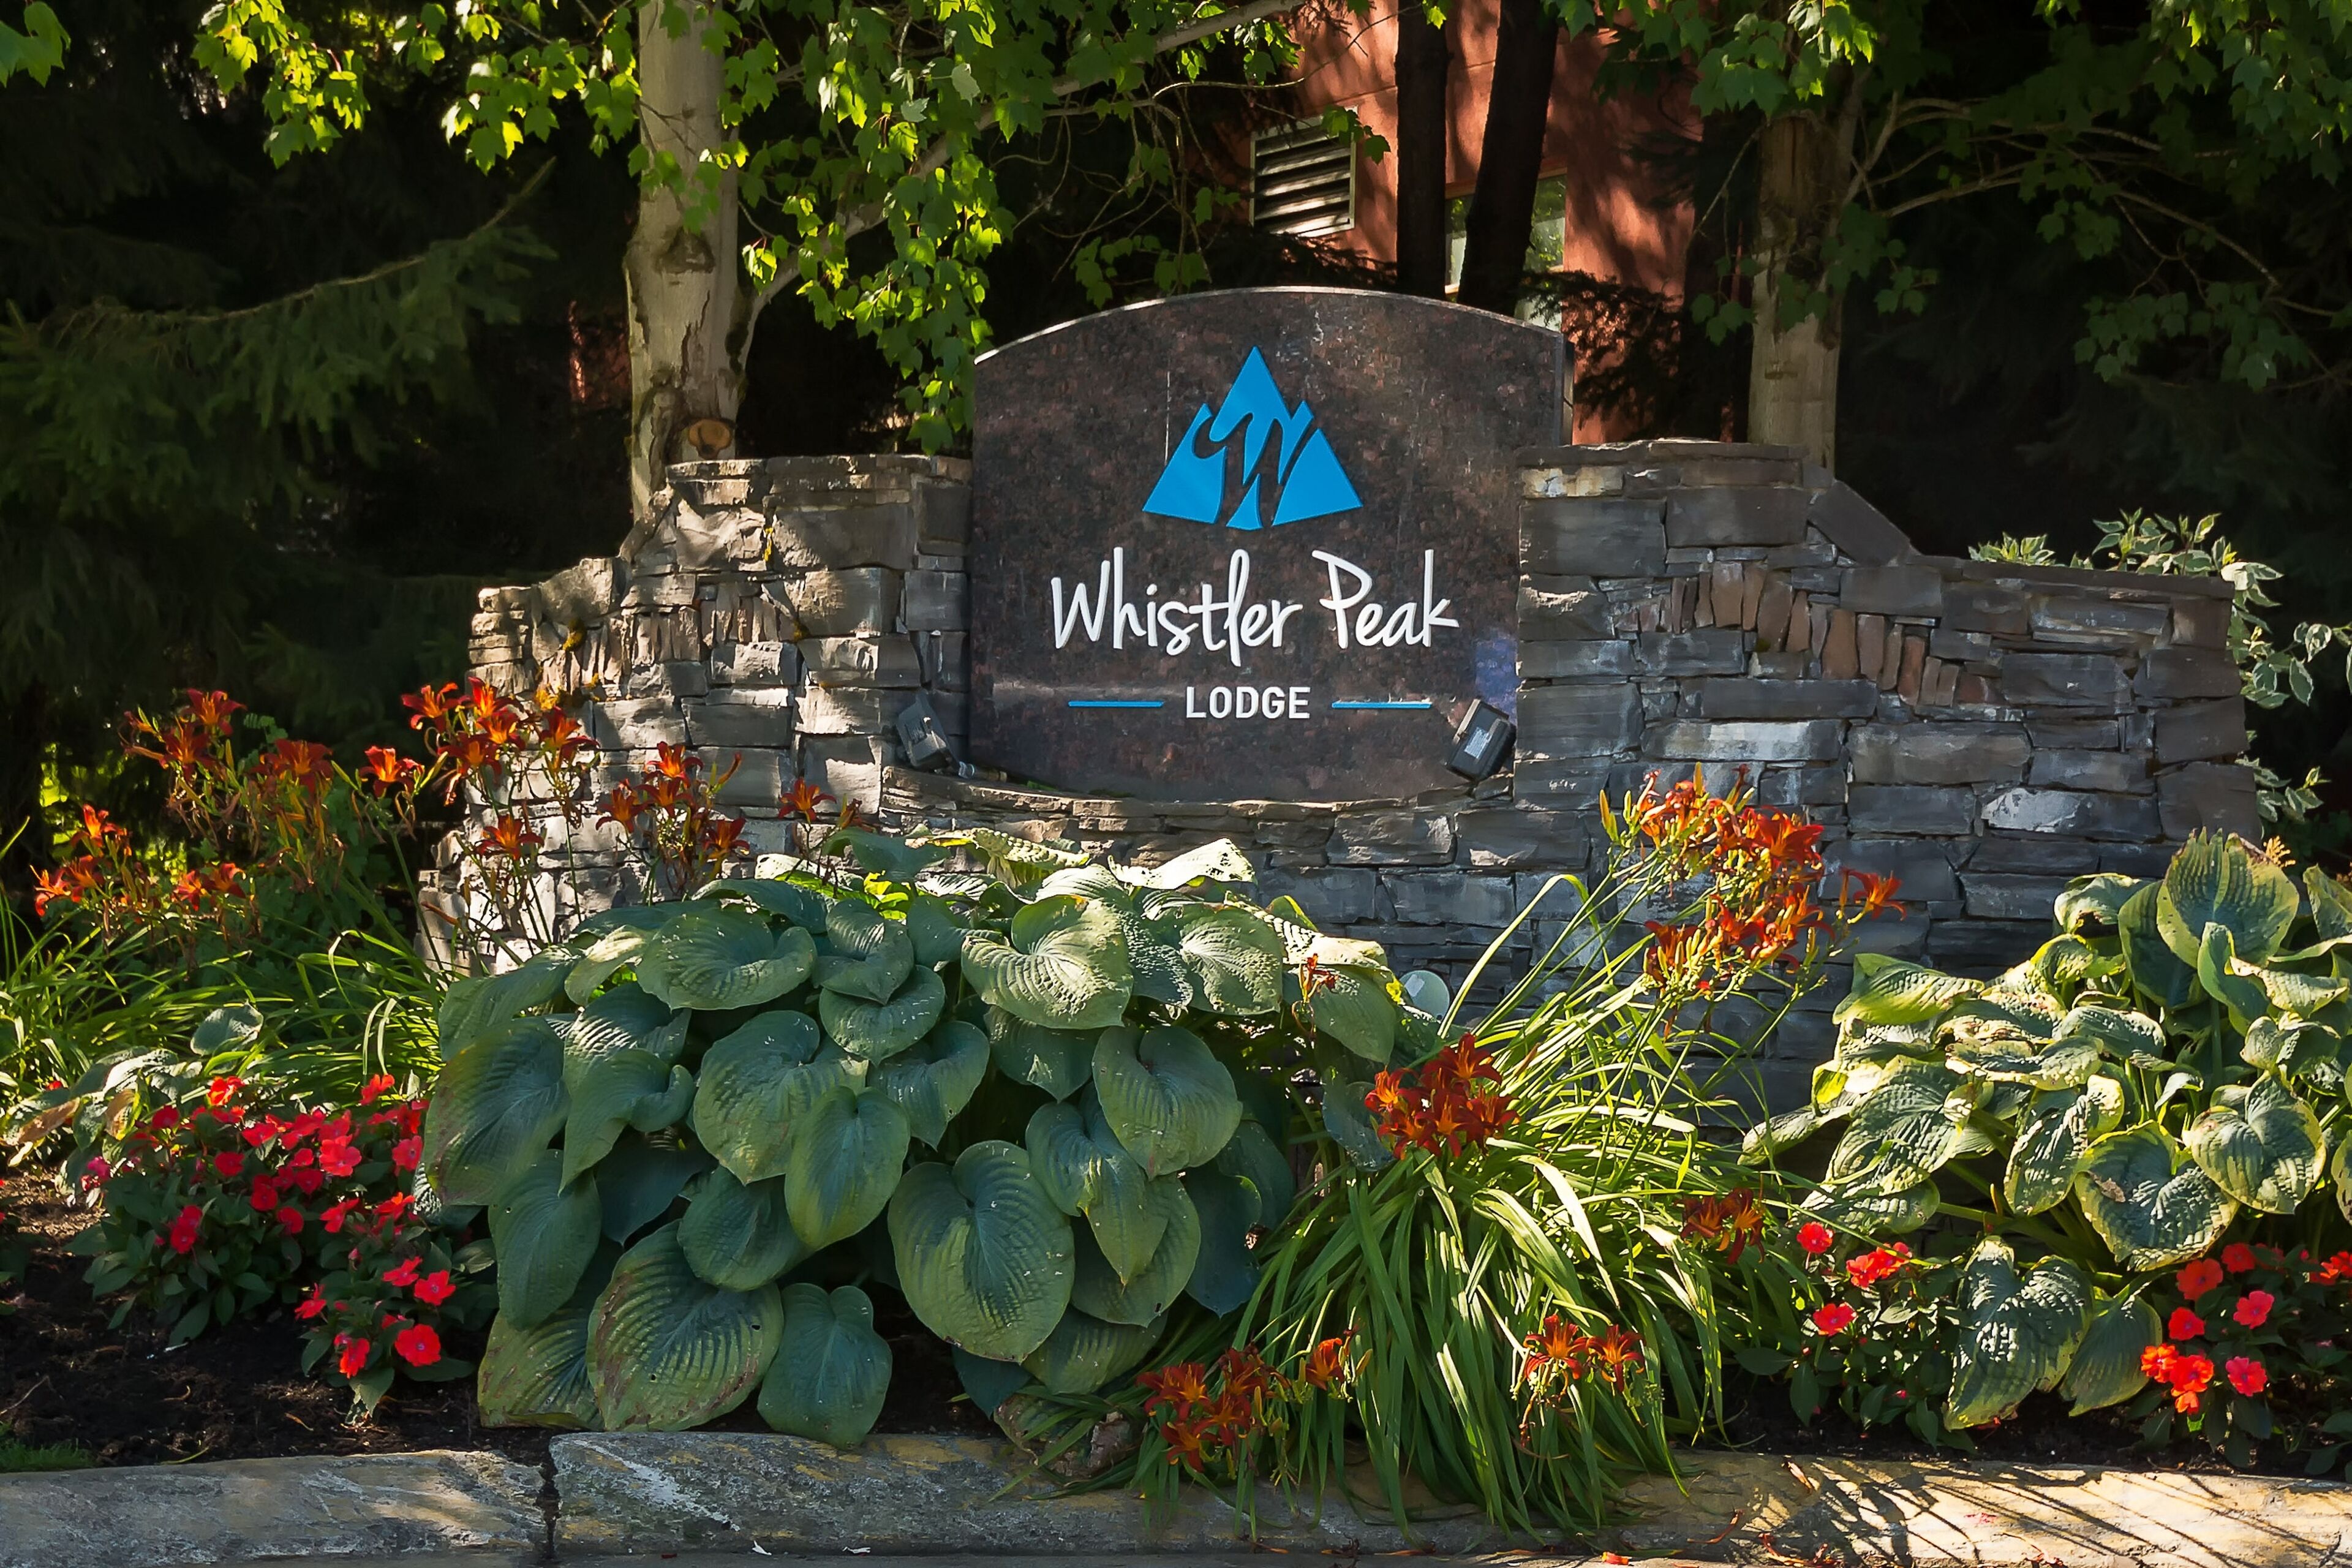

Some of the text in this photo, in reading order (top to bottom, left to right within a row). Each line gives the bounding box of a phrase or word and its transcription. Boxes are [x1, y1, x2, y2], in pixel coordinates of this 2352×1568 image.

[1050, 546, 1460, 667] Whistler Peak
[1186, 686, 1311, 719] LODGE
